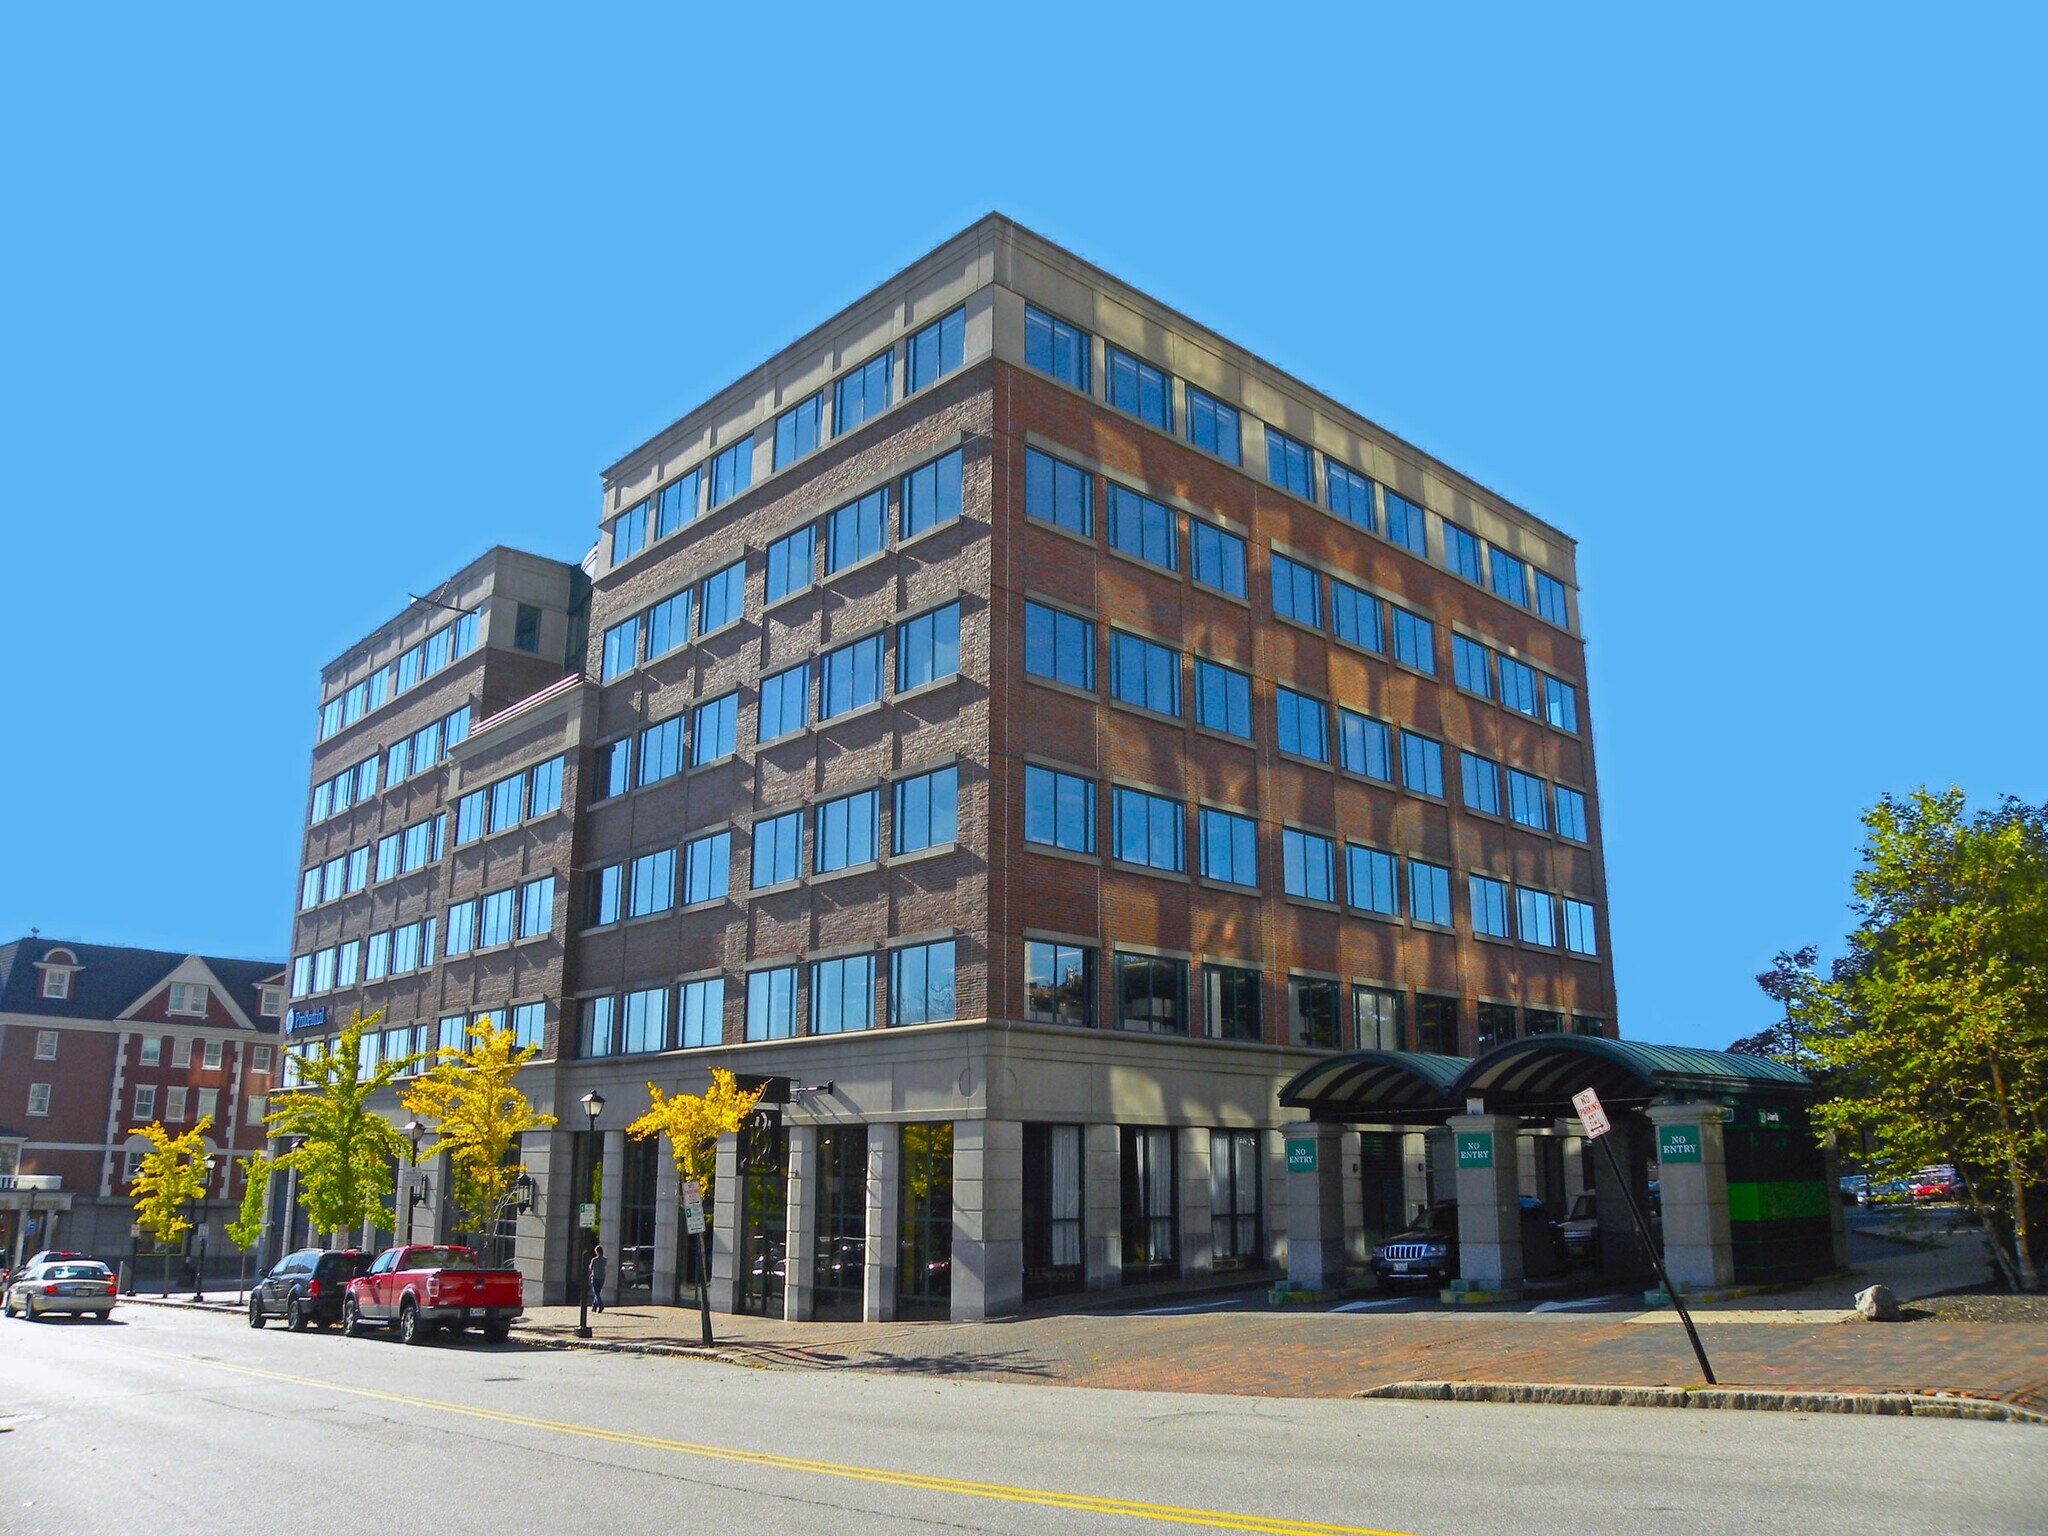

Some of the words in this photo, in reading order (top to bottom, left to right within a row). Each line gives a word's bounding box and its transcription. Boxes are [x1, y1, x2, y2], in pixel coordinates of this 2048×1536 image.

[294, 1007, 325, 1028] Prudential
[1581, 1094, 1591, 1105] NO
[1580, 1101, 1600, 1115] PARKING
[1671, 1135, 1686, 1144] NO
[1467, 1142, 1480, 1150] NO
[1663, 1144, 1696, 1154] ENTRY
[1295, 1148, 1306, 1156] NO
[1460, 1150, 1489, 1159] ENTRY
[1289, 1155, 1313, 1164] ENTRY
